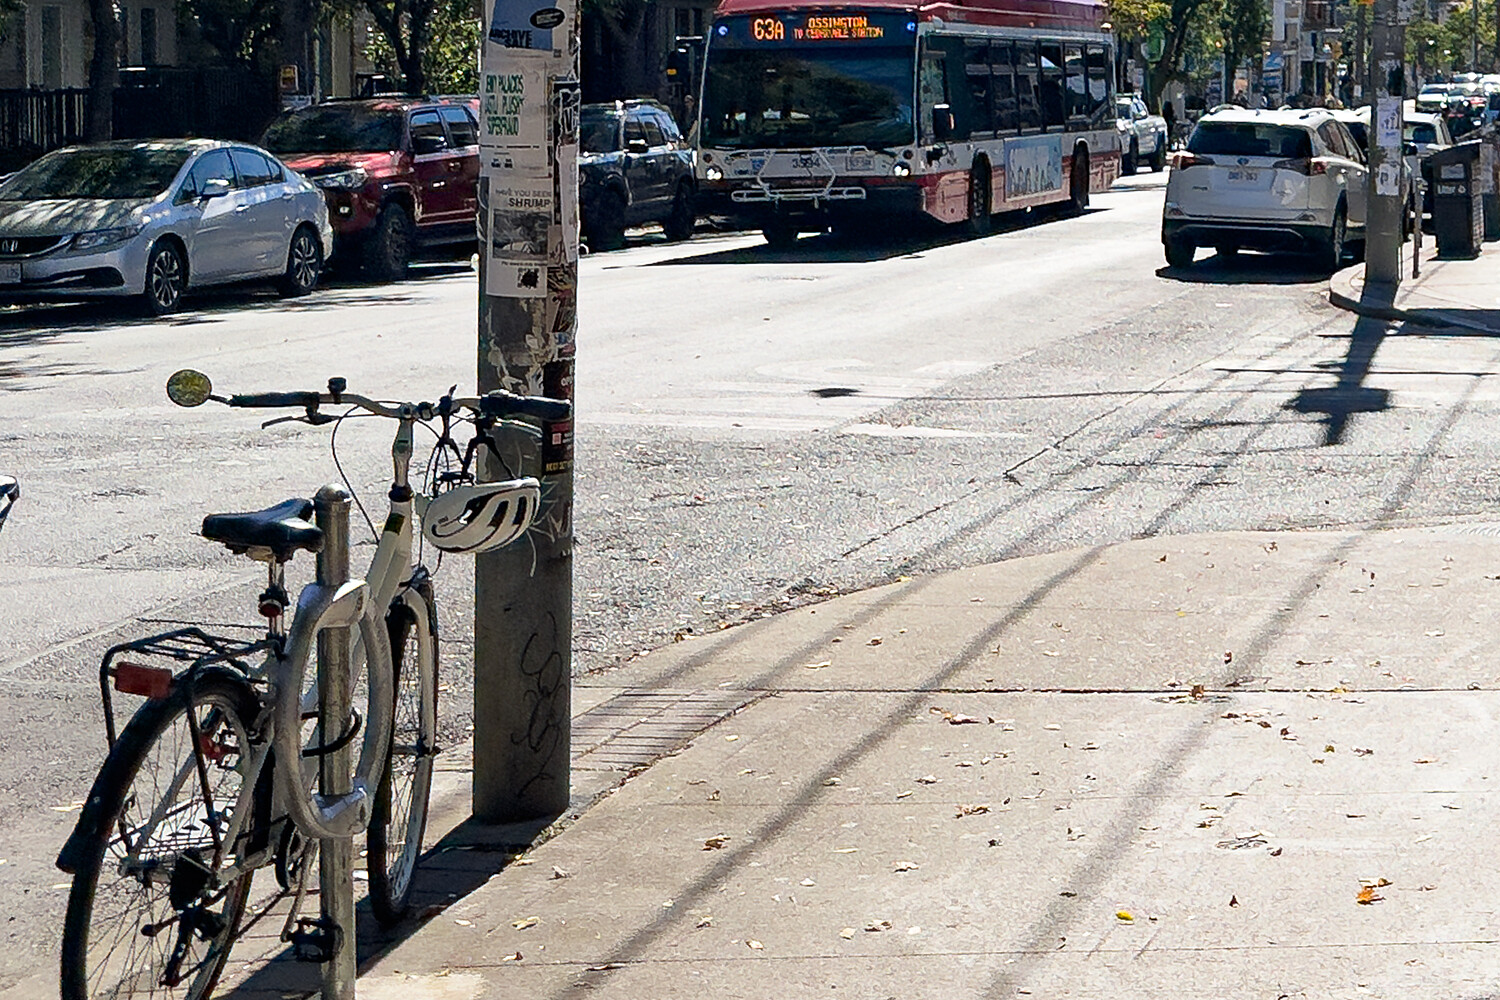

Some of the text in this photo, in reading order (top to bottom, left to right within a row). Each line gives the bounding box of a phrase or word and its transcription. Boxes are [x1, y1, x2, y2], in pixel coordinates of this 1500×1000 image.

[808, 16, 867, 28] OSSINGTON
[754, 18, 784, 40] 63A
[514, 189, 530, 197] YOU
